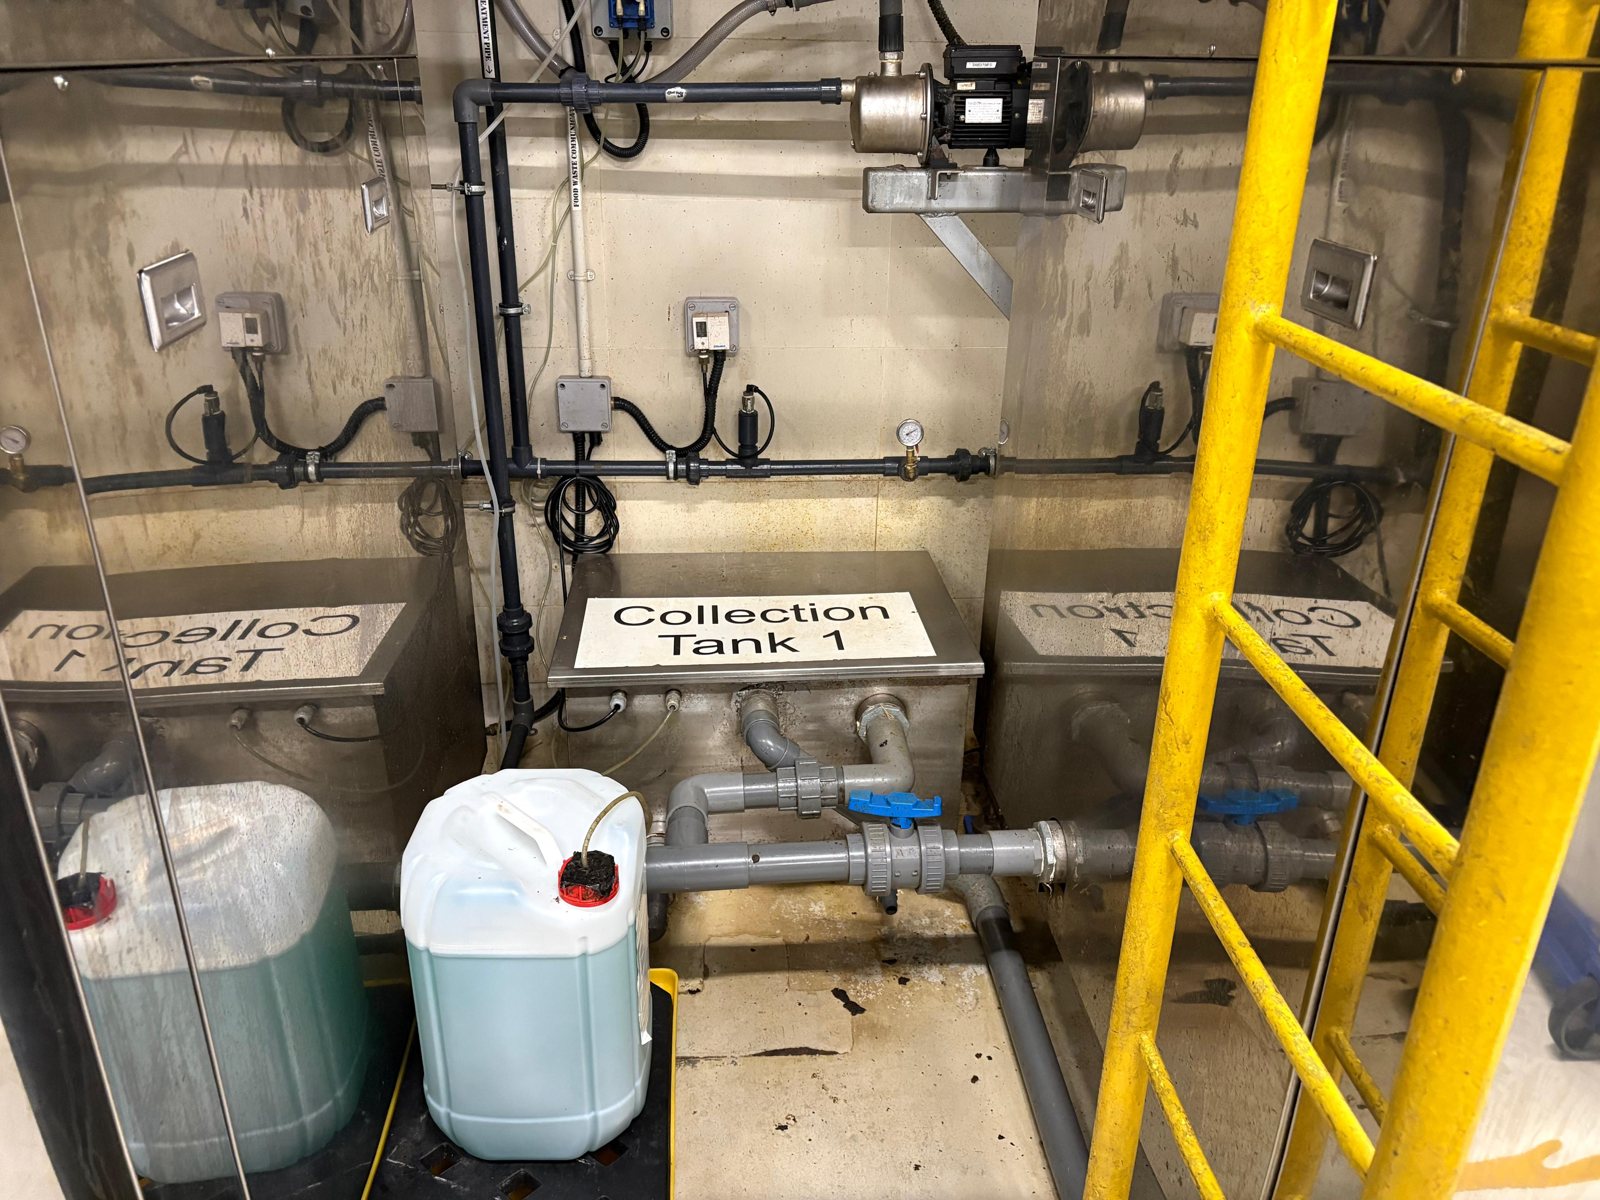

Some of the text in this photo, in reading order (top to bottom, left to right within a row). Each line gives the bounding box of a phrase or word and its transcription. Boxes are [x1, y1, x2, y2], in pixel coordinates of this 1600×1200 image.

[484, 42, 492, 61] PIPE
[571, 160, 579, 186] WASTE
[613, 602, 890, 627] Collection
[658, 630, 846, 657] Tank 1
